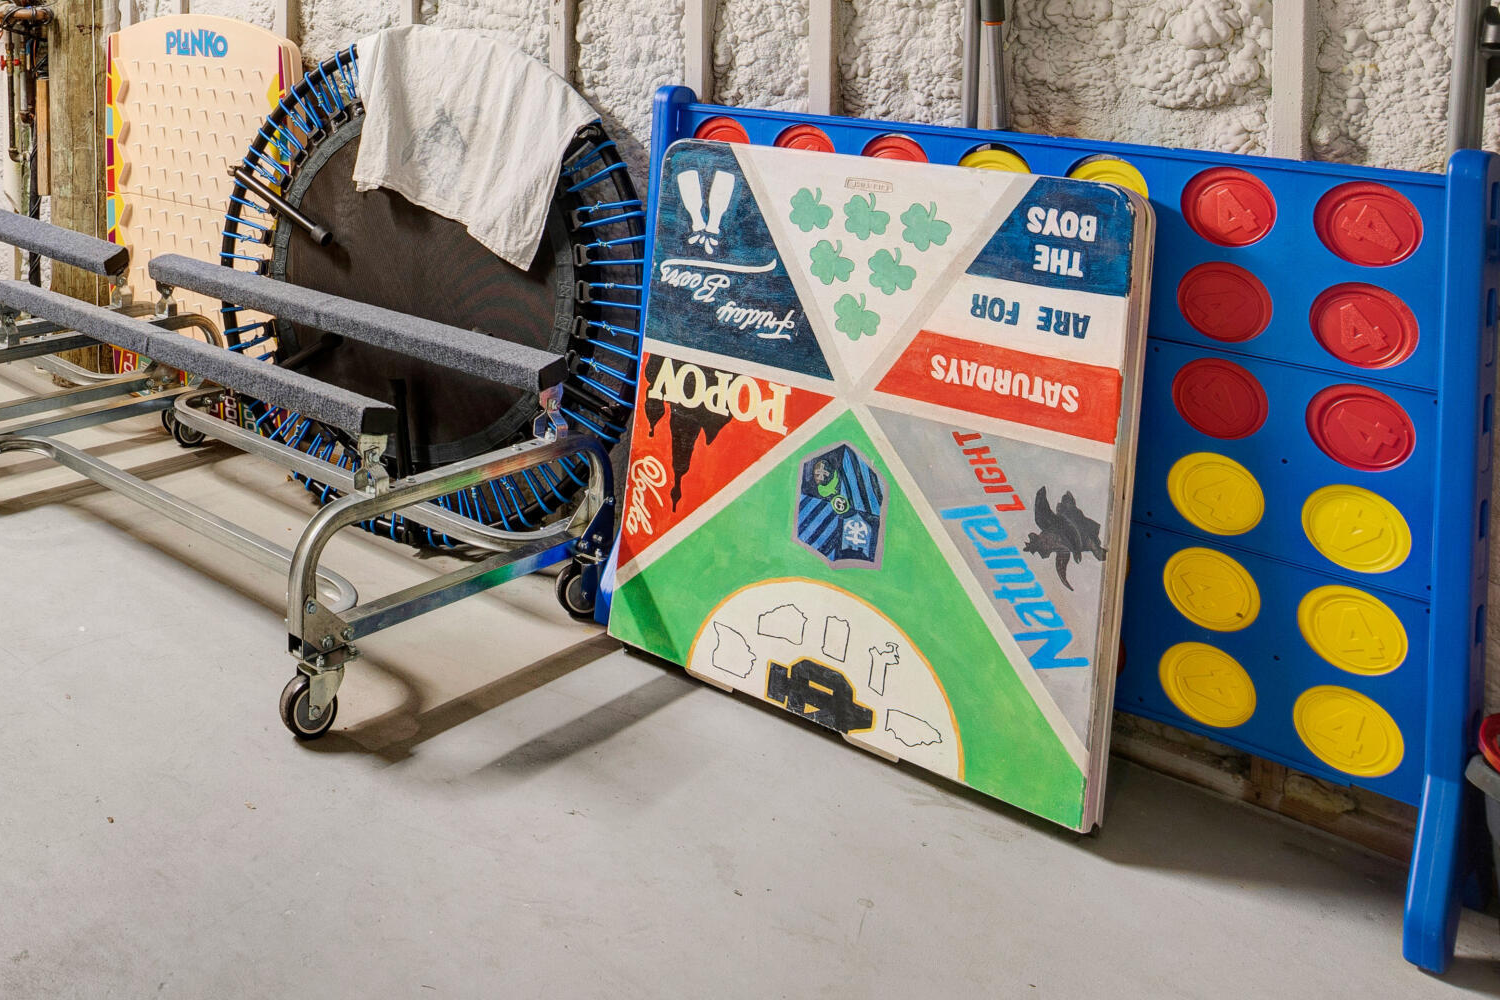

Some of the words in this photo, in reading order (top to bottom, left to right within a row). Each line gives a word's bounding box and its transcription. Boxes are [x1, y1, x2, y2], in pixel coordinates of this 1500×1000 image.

[166, 29, 228, 58] PLINKO
[1026, 206, 1097, 242] BOYS
[1033, 244, 1084, 278] THE
[660, 266, 730, 303] Beers
[715, 301, 795, 340] Friday
[970, 293, 1020, 326] FOR
[1036, 306, 1091, 339] ARE
[648, 357, 792, 436] POPOV
[930, 354, 1080, 413] SATURDAYS
[952, 431, 1026, 512] LIGHT
[626, 455, 667, 536] Vodka
[940, 504, 1089, 670] Natural
